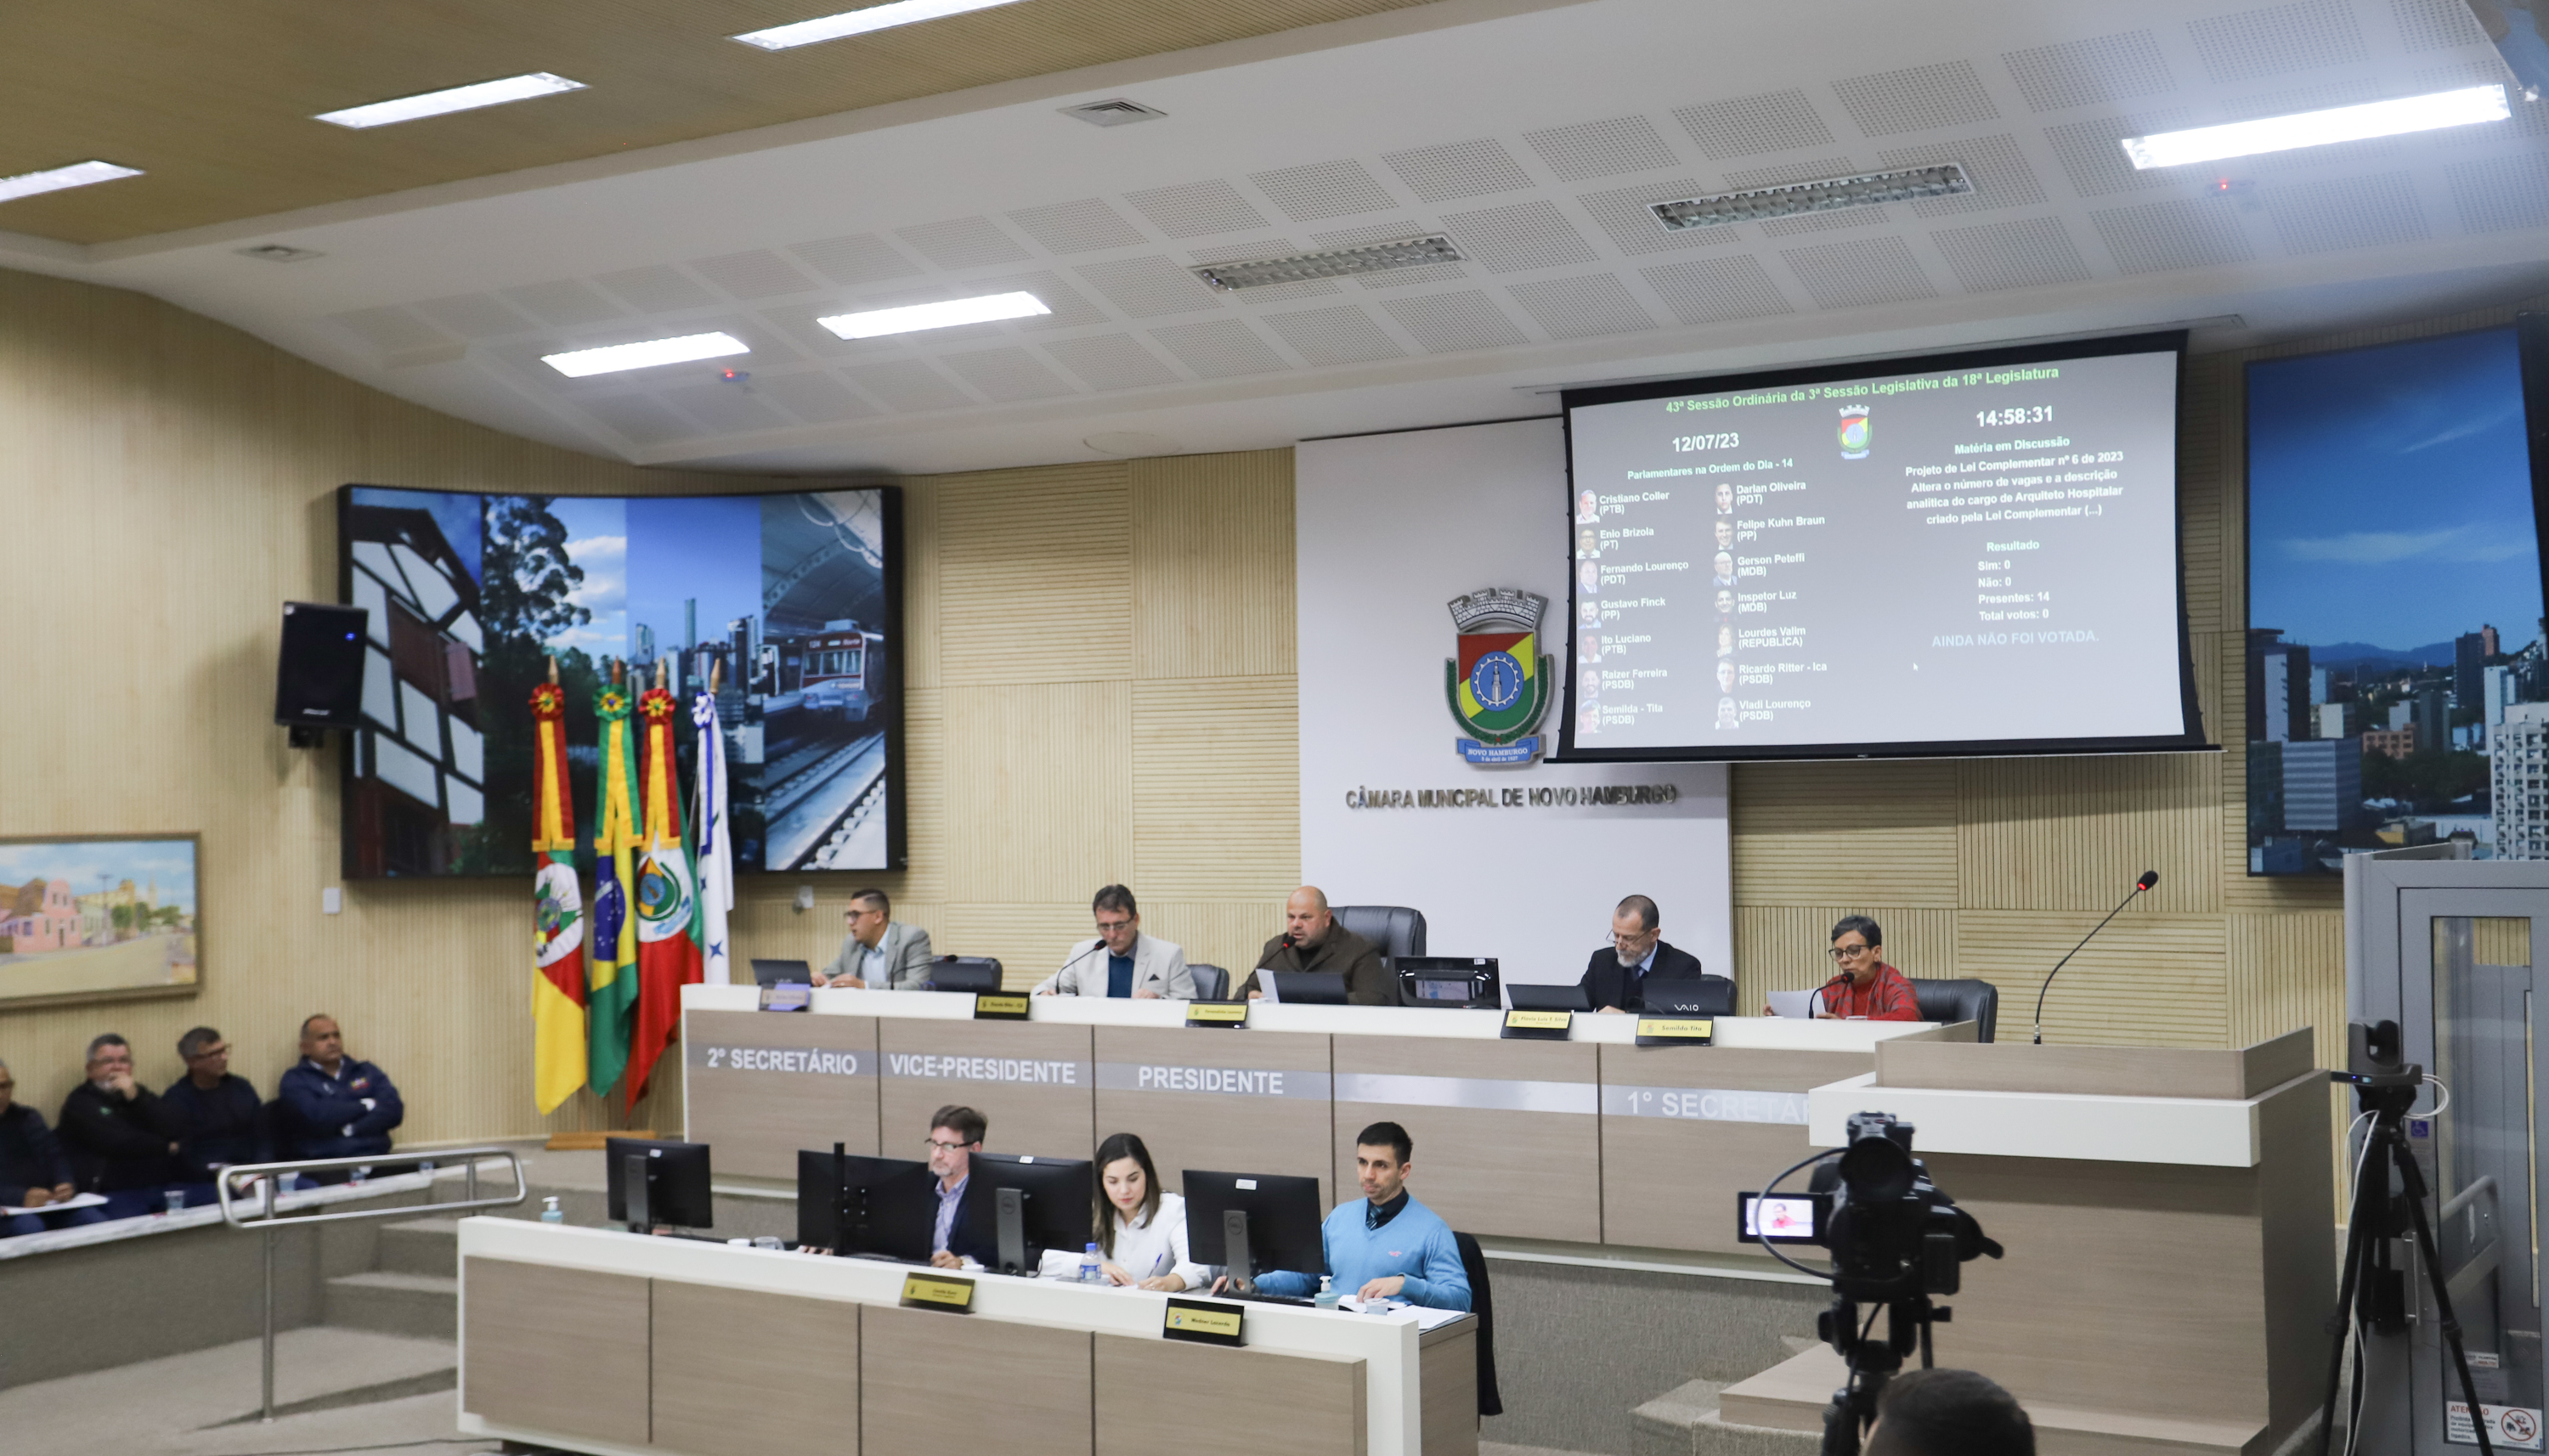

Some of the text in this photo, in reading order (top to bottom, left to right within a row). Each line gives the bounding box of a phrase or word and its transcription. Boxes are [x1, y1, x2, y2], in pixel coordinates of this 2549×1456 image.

[1666, 369, 2059, 412] 43ª Sessão Ordinária da 3ª Sessão Legislativa da 18ª Legislatura
[1977, 405, 2052, 426] 14:58:31
[1673, 432, 1739, 452] 12/07/23
[1955, 437, 2070, 454] Matéria em Discussão
[1628, 468, 1693, 479] Parlamentares
[1709, 464, 1740, 473] Ordem
[1743, 461, 1755, 471] do
[1758, 460, 1772, 470] Dia
[1782, 458, 1793, 467] 14
[1906, 466, 1941, 479] Projeto
[1945, 464, 1957, 473] de
[1960, 462, 1975, 472] Lei
[1979, 458, 2055, 471] Complementar
[2072, 454, 2078, 464] 6
[2082, 454, 2094, 463] de
[2098, 451, 2123, 462] 2023
[1912, 483, 1941, 493] Altera
[1953, 479, 1993, 489] número
[1996, 477, 2009, 487] de
[2011, 477, 2043, 487] vagas
[2065, 469, 2117, 484] descrição
[1737, 481, 1806, 494] Darlan Oliveira
[1600, 492, 1670, 504] Cristiano Coller
[1737, 494, 1762, 505] (PDT)
[1952, 496, 1964, 505] do
[1968, 496, 1997, 508] cargo
[2000, 494, 2013, 503] de
[2015, 490, 2065, 503] Arquiteto
[2068, 486, 2123, 499] Hospitalar
[1600, 505, 1625, 516] (PTB)
[1927, 514, 1958, 524] criado
[1961, 512, 1982, 524] pela
[1986, 511, 2001, 521] Lei
[2004, 505, 2082, 520] Complementar
[1738, 516, 1825, 530] Felipe Kuhn Braun
[1601, 527, 1653, 539] Enio Brizola
[1738, 531, 1756, 542] (PP)
[1600, 540, 1618, 550] (PT)
[1987, 540, 2039, 551] Resultado
[1738, 555, 1772, 565] Gerson
[1978, 560, 2010, 571] Sim: 0
[1601, 562, 1688, 573] Fernando Lourenço
[1738, 567, 1766, 578] (MDB)
[1601, 574, 1625, 585] (PDT)
[1979, 577, 2011, 587] Não: 0
[1601, 597, 1665, 608] Gustavo Finck
[1738, 590, 1796, 603] Inspetor Luz
[1979, 591, 2049, 604] Presentes: 14
[1738, 602, 1766, 614] (MDB)
[1602, 610, 1619, 620] (PP)
[1979, 609, 2049, 620] Total votos: 0
[1739, 626, 1806, 638] Lourdes Valim
[1602, 635, 1651, 644] Ito Luciano
[1739, 636, 1802, 649] (REPUBLICA)
[1932, 635, 1974, 646] AINDA
[1978, 633, 2007, 645] NÃO
[2012, 632, 2033, 644] FOI
[1602, 645, 1626, 656] (PTB)
[1602, 669, 1667, 679] Raizer Ferreira
[1739, 664, 1775, 674] Ricardo
[1778, 663, 1804, 672] Ritter
[1813, 663, 1827, 671] Ica
[1602, 680, 1634, 690] (PSDB)
[1739, 674, 1772, 686] (PSDB)
[1602, 704, 1637, 714] Semilda
[1647, 703, 1663, 712] Tita
[1740, 700, 1811, 709] Vladi Lourenço
[1602, 715, 1634, 725] (PSDB)
[1740, 711, 1773, 722] (PSDB)
[1417, 787, 1499, 808] MUNICIPAL
[1501, 787, 1523, 807] DE
[1529, 786, 1577, 807] NOVO
[1580, 783, 1678, 806] HAMBURGO
[707, 1047, 857, 1075] 2º SECRETÁRIO
[890, 1052, 1076, 1085] VICE-PRESIDENTE
[1138, 1065, 1284, 1095] PRESIDENTE
[1628, 1091, 1653, 1115] 1º
